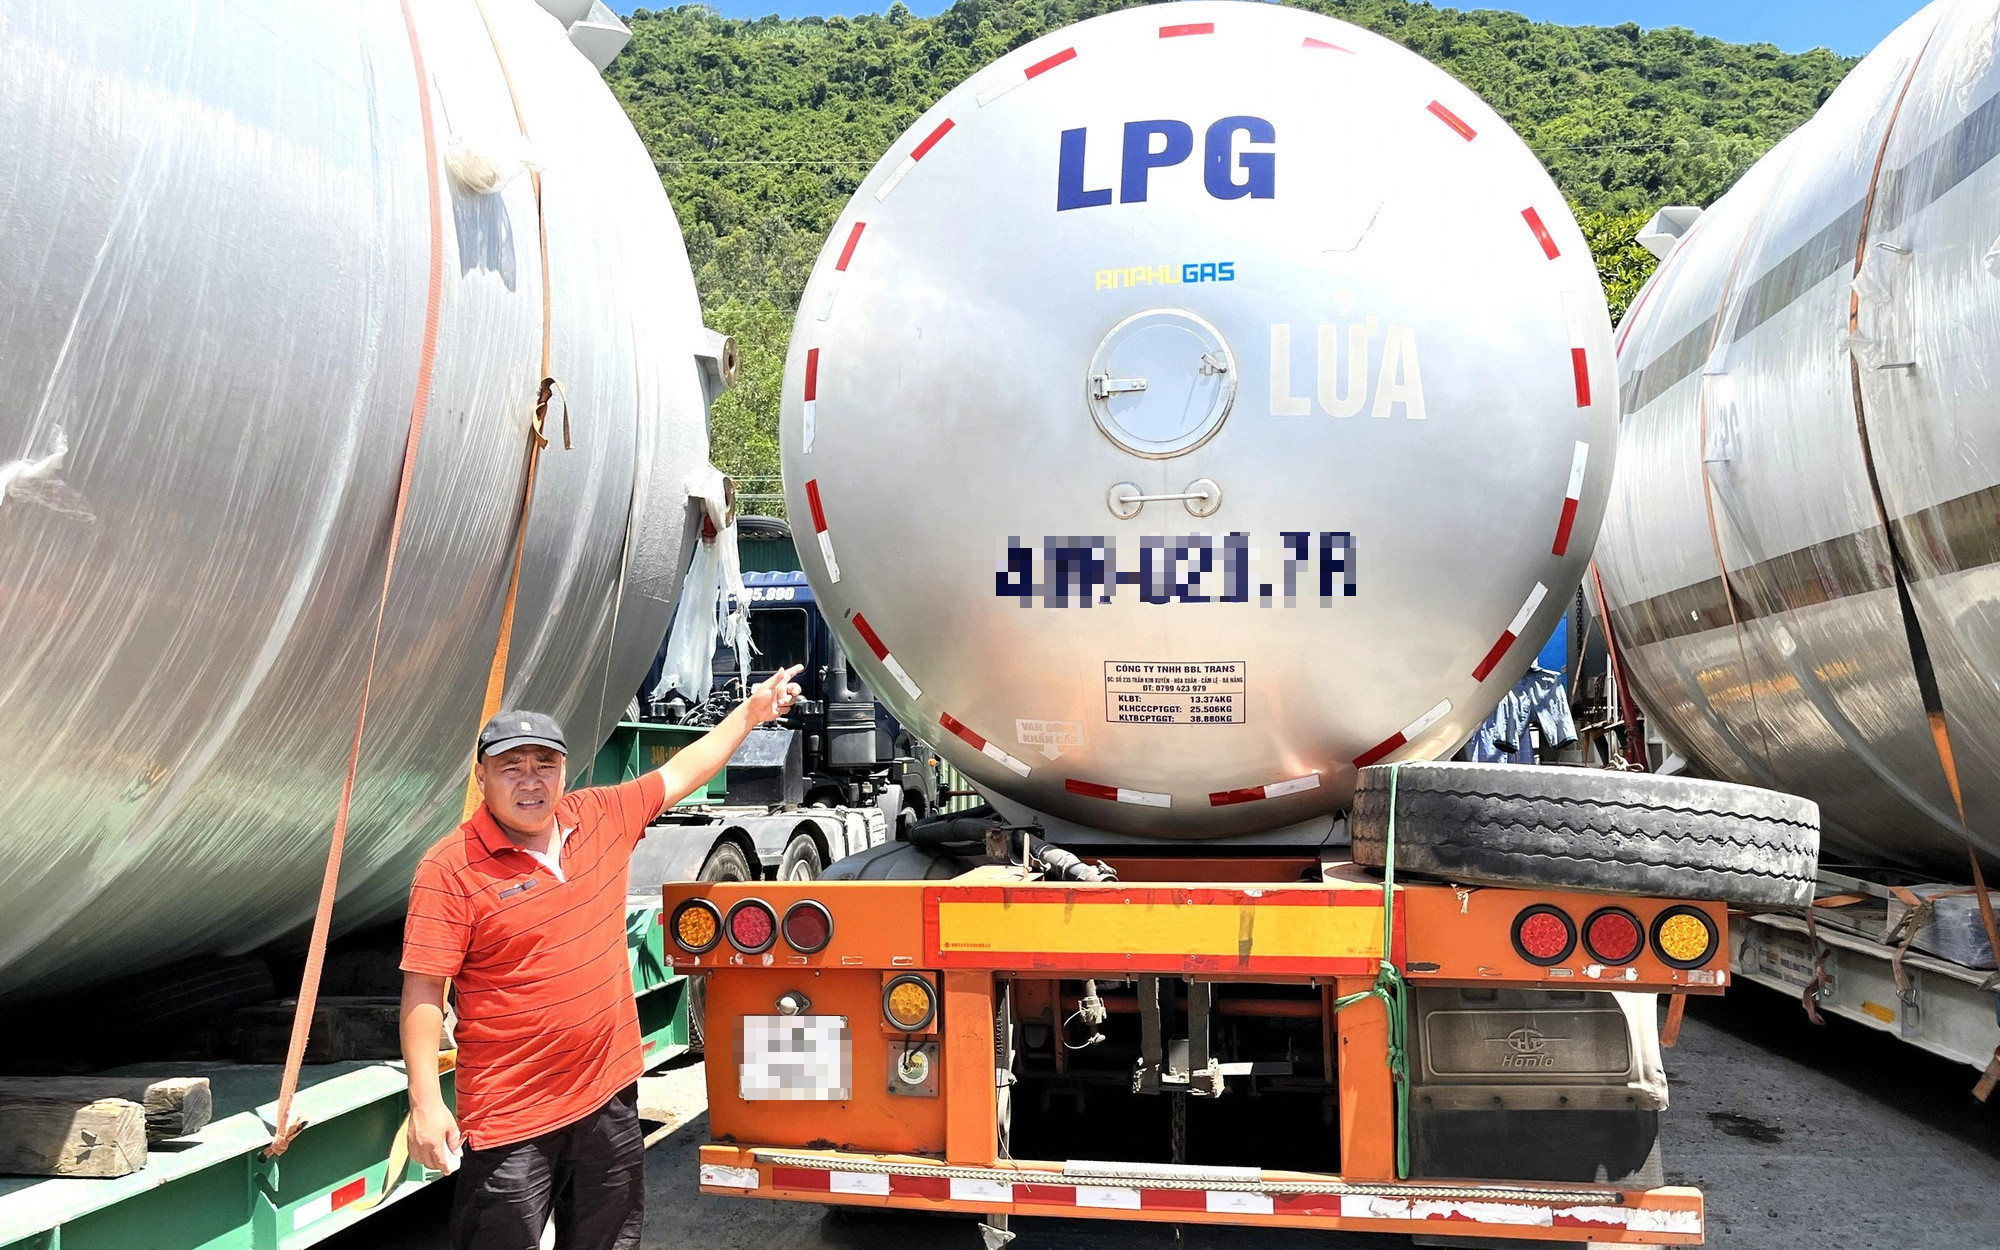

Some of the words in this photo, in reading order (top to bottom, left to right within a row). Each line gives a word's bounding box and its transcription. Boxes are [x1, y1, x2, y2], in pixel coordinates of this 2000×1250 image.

[1057, 115, 1276, 212] LPG
[1269, 290, 1427, 420] LỬA
[1115, 664, 1141, 673] CÔNG
[1144, 665, 1154, 673] TY
[1157, 665, 1181, 674] TNHH
[1184, 666, 1202, 674] BBL
[1204, 665, 1235, 673] TRANS
[1155, 684, 1174, 692] 0799
[1192, 684, 1207, 692] 979
[1118, 695, 1142, 703] KLBT:
[1190, 695, 1232, 703] 13.374KG
[1118, 704, 1182, 713] KLHCCCPTGGT:
[1190, 705, 1232, 713] 25.506KG
[1119, 714, 1175, 722] KLTBCPTGGT:
